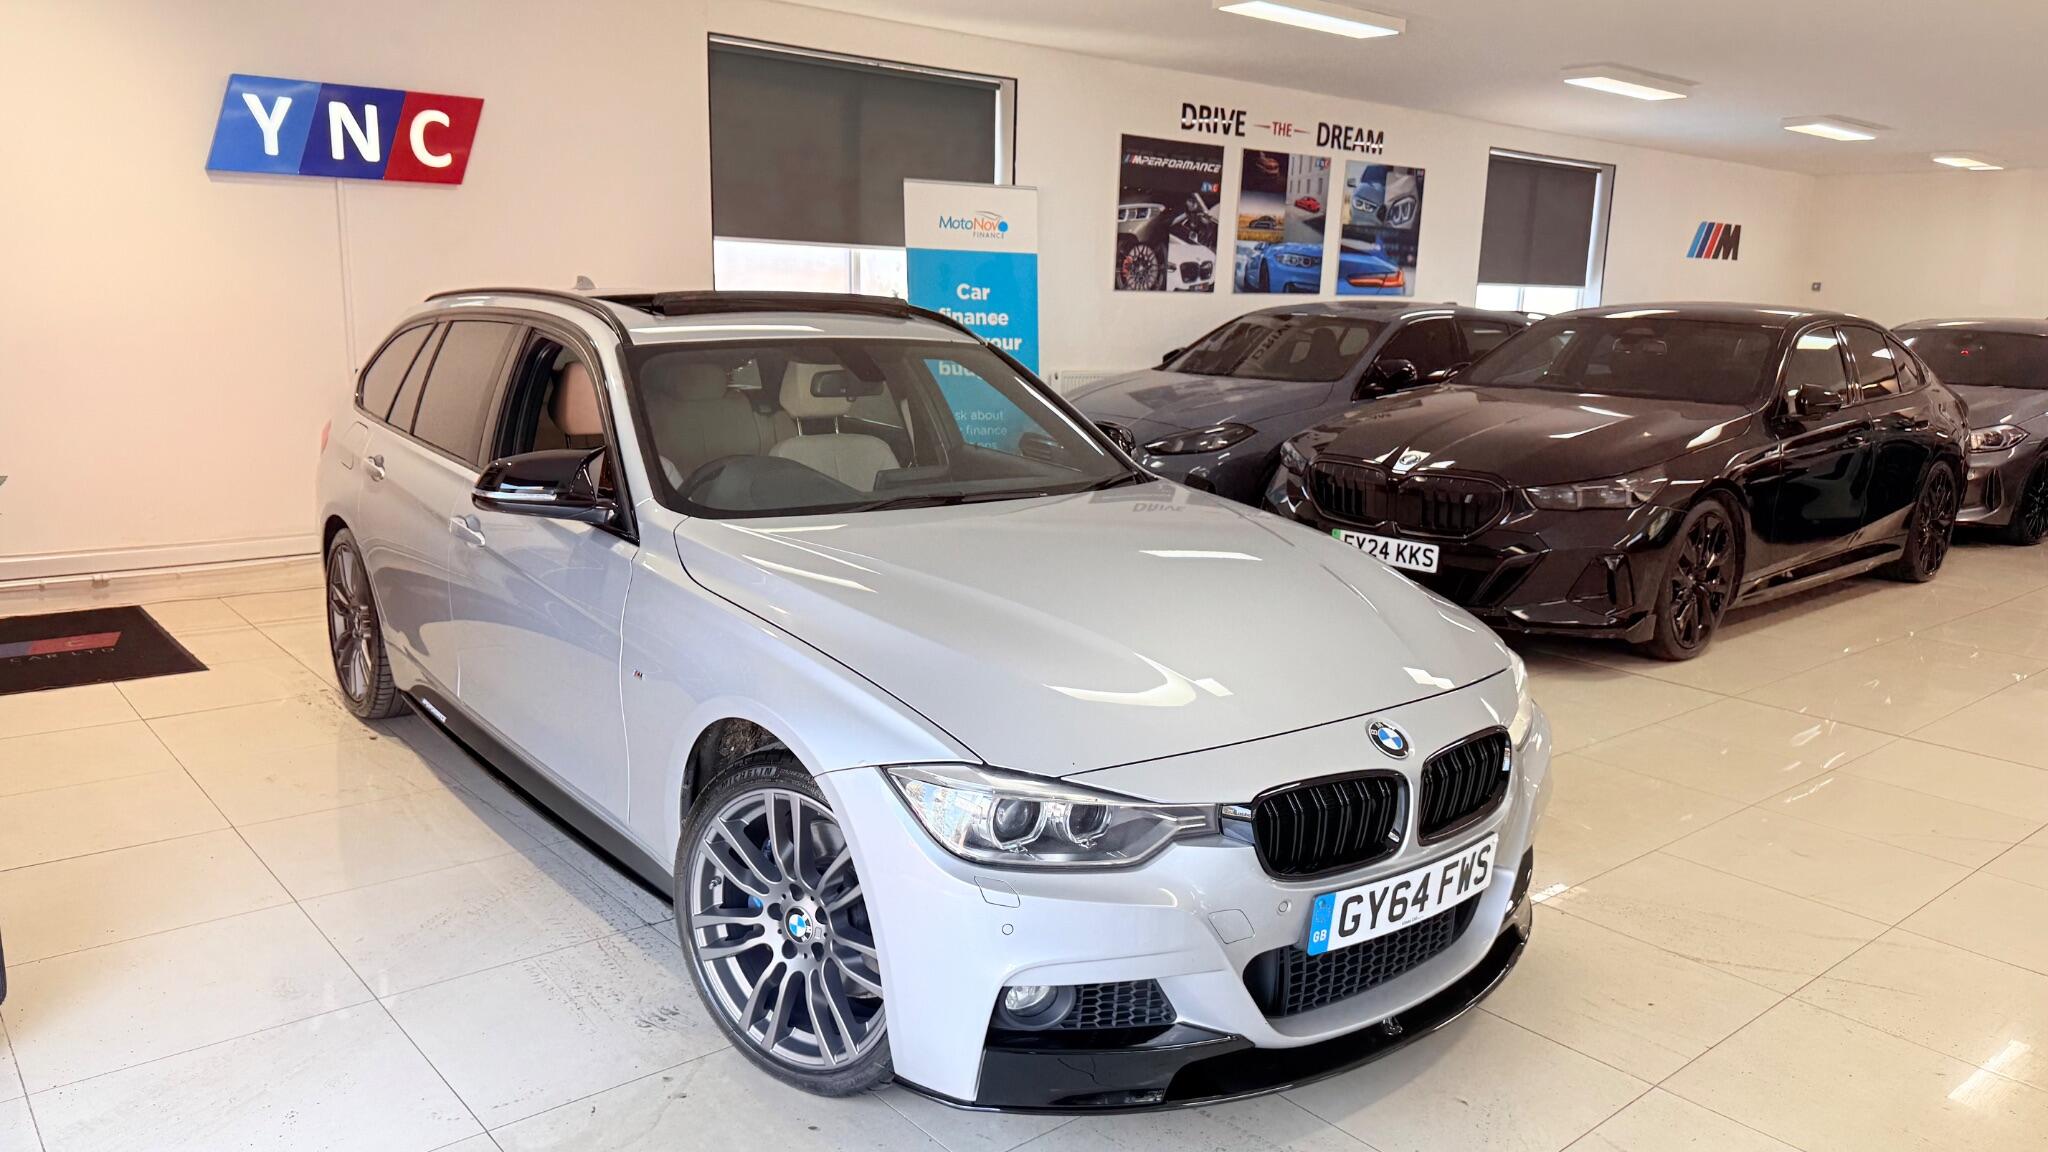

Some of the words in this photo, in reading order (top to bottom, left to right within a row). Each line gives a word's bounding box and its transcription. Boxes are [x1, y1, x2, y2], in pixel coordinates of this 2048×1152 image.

[241, 92, 453, 168] YNC
[1181, 102, 1247, 137] DRIVE
[1272, 121, 1293, 137] THE
[1316, 121, 1385, 155] DREAM
[973, 231, 1005, 239] FINANCE
[956, 283, 990, 300] Car
[984, 337, 1022, 351] our
[954, 409, 967, 420] sk
[970, 409, 1004, 420] about
[966, 424, 1008, 437] finance
[1395, 543, 1435, 567] KKS
[1338, 871, 1432, 938] GY64
[1437, 844, 1492, 905] FWS
[1313, 928, 1328, 943] GB
